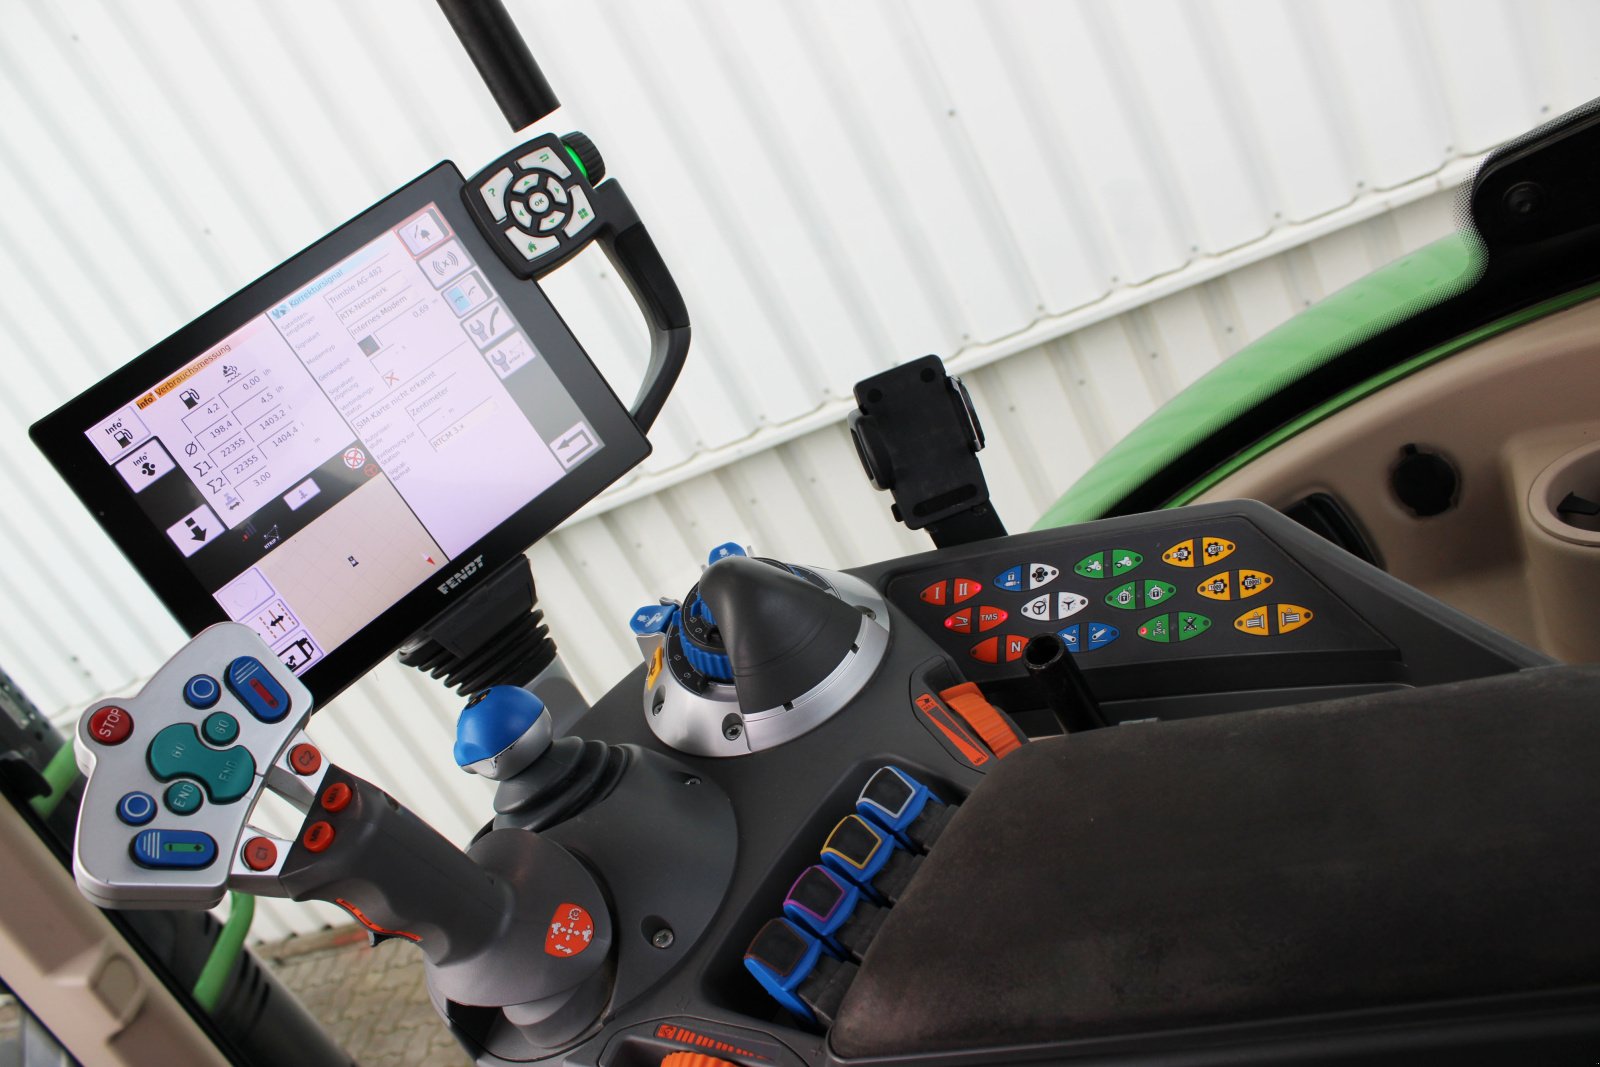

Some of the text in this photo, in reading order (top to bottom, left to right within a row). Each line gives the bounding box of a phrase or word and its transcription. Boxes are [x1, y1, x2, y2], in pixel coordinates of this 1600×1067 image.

[534, 198, 545, 207] OK
[288, 270, 344, 309] Korrektursignal
[329, 266, 383, 304] Trimble AG-482
[340, 286, 388, 321] RTK-Netzwerk
[351, 295, 407, 335] Internes Modem
[413, 304, 429, 319] 0,69
[155, 343, 231, 396] Verbrauchsmessung
[207, 402, 221, 415] 4,2
[242, 376, 261, 391] 0,00
[356, 371, 437, 429] SIM-Karte nicht erkannt
[410, 387, 449, 416] Zentimeter
[209, 420, 233, 439] 198,4
[260, 392, 273, 405] 4,5
[220, 437, 246, 457] 22355
[259, 410, 286, 431] 1403,2
[433, 430, 453, 448] RTCM
[233, 454, 258, 475] 22355
[272, 427, 299, 448] 1404,4
[252, 471, 271, 487] 3,00
[437, 554, 483, 595] FENDT
[980, 613, 998, 622] TMS
[1011, 641, 1021, 653] N
[99, 708, 122, 738] STOP
[215, 719, 229, 734] GO
[218, 760, 237, 783] END
[299, 750, 314, 765] C2
[173, 784, 194, 809] END
[255, 846, 269, 861] C1
